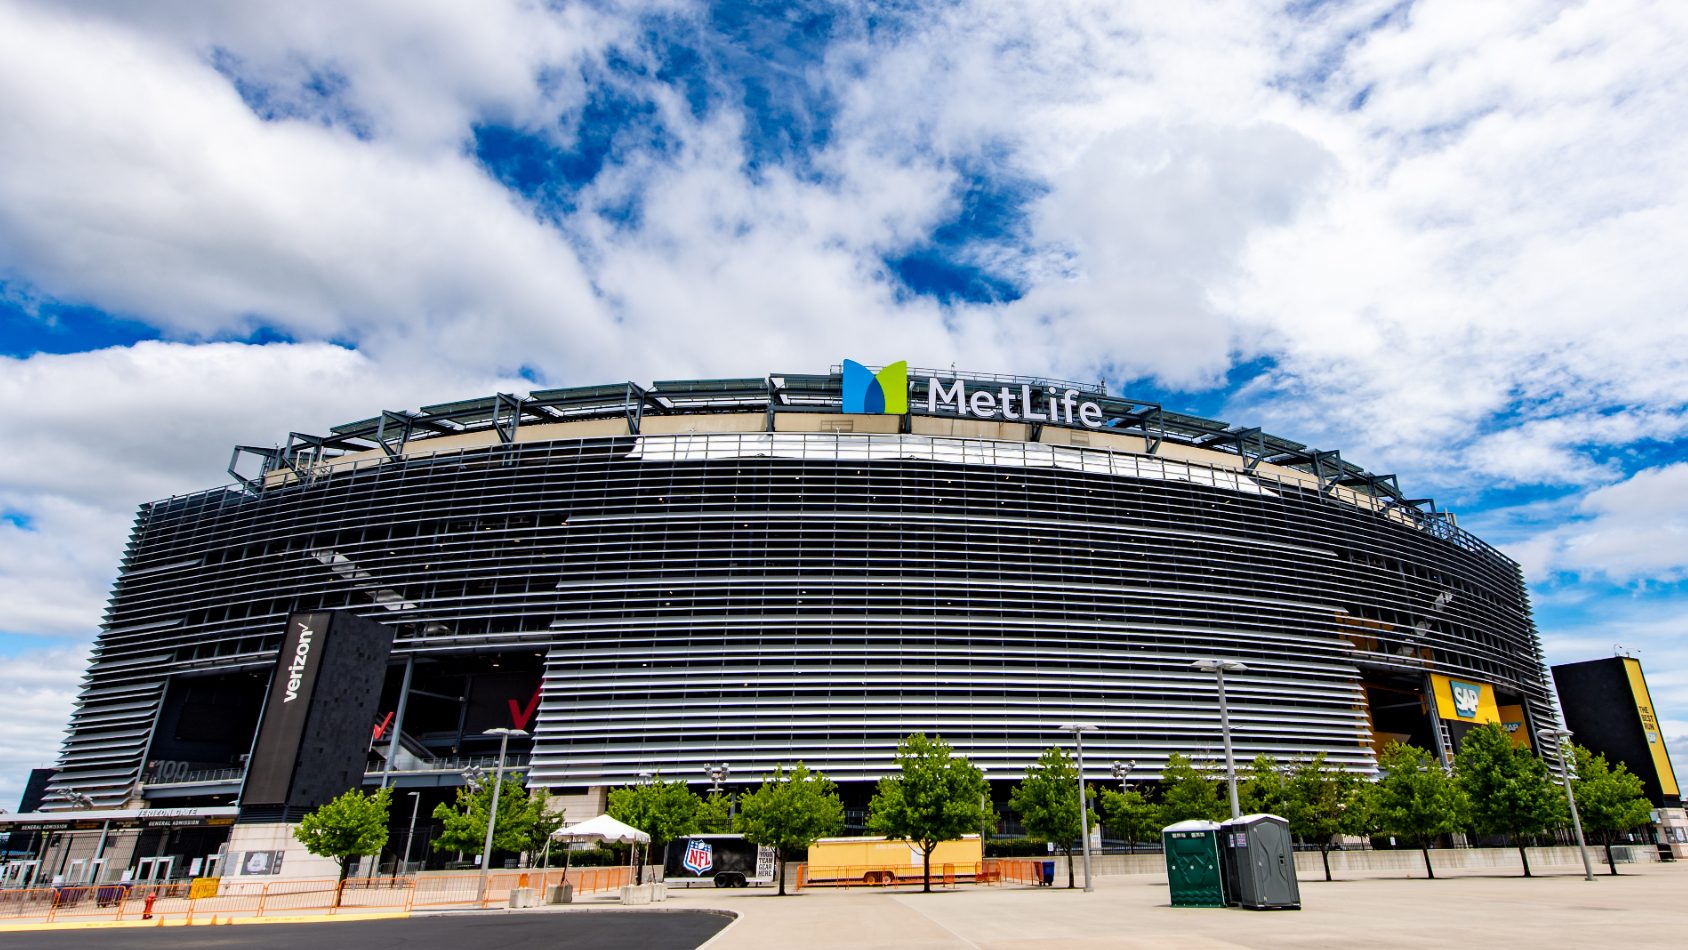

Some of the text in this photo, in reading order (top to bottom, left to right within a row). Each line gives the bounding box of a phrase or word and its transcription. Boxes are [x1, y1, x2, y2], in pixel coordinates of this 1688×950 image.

[928, 377, 1103, 428] MetLife
[284, 630, 313, 702] verizon
[1454, 686, 1479, 712] SAP
[1639, 706, 1649, 714] THE
[1641, 714, 1654, 722] BEST
[689, 849, 711, 868] NFL
